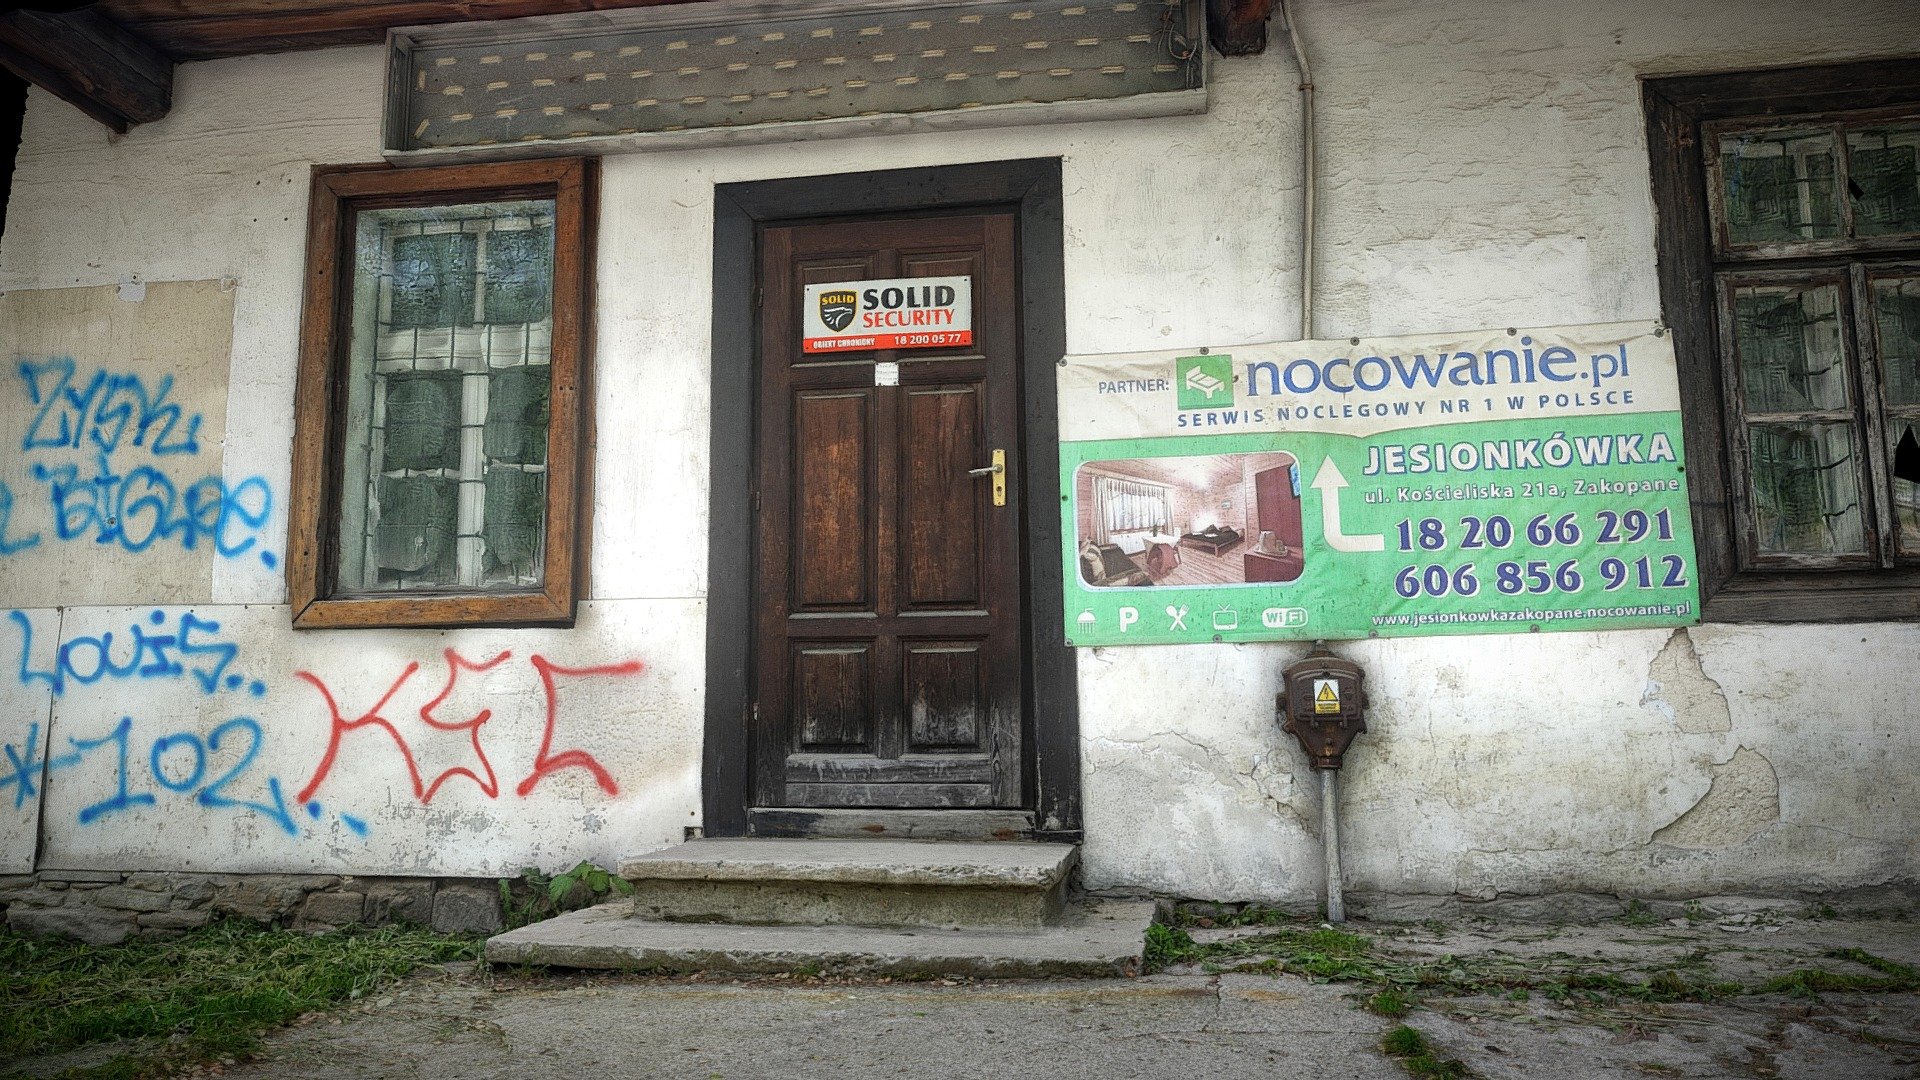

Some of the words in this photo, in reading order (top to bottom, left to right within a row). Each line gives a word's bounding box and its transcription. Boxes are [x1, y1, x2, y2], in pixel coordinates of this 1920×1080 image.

[822, 295, 855, 305] SOLID
[863, 285, 956, 310] SOLID
[863, 309, 955, 328] SECURITY
[894, 335, 907, 345] 18
[910, 334, 929, 344] 200
[932, 334, 945, 343] 05
[948, 333, 961, 343] 77
[1246, 336, 1631, 397] nocowanie.pl
[1098, 379, 1170, 394] PARTNER:
[1177, 409, 1265, 427] SERWIS
[1277, 400, 1426, 421] NOCLEGOWY
[1440, 398, 1470, 414] NR
[1485, 398, 1493, 411] 1
[1507, 395, 1525, 410] W
[1538, 390, 1635, 408] POLSCE
[1362, 431, 1678, 476] JESIONKÓWKA
[1364, 487, 1391, 503] ul.
[1396, 482, 1515, 502] Kościeliska
[1520, 481, 1567, 499] 21a,
[1573, 477, 1680, 498] Zakopane
[1394, 517, 1447, 551] 18
[1459, 515, 1515, 549] 20
[1526, 512, 1582, 547] 66
[1595, 507, 1676, 544] 291
[1394, 562, 1480, 599] 606
[1496, 559, 1584, 595] 856
[1600, 553, 1689, 592] 912
[1371, 600, 1692, 627] www.jesionkowkazakopane.nocowanie.pl
